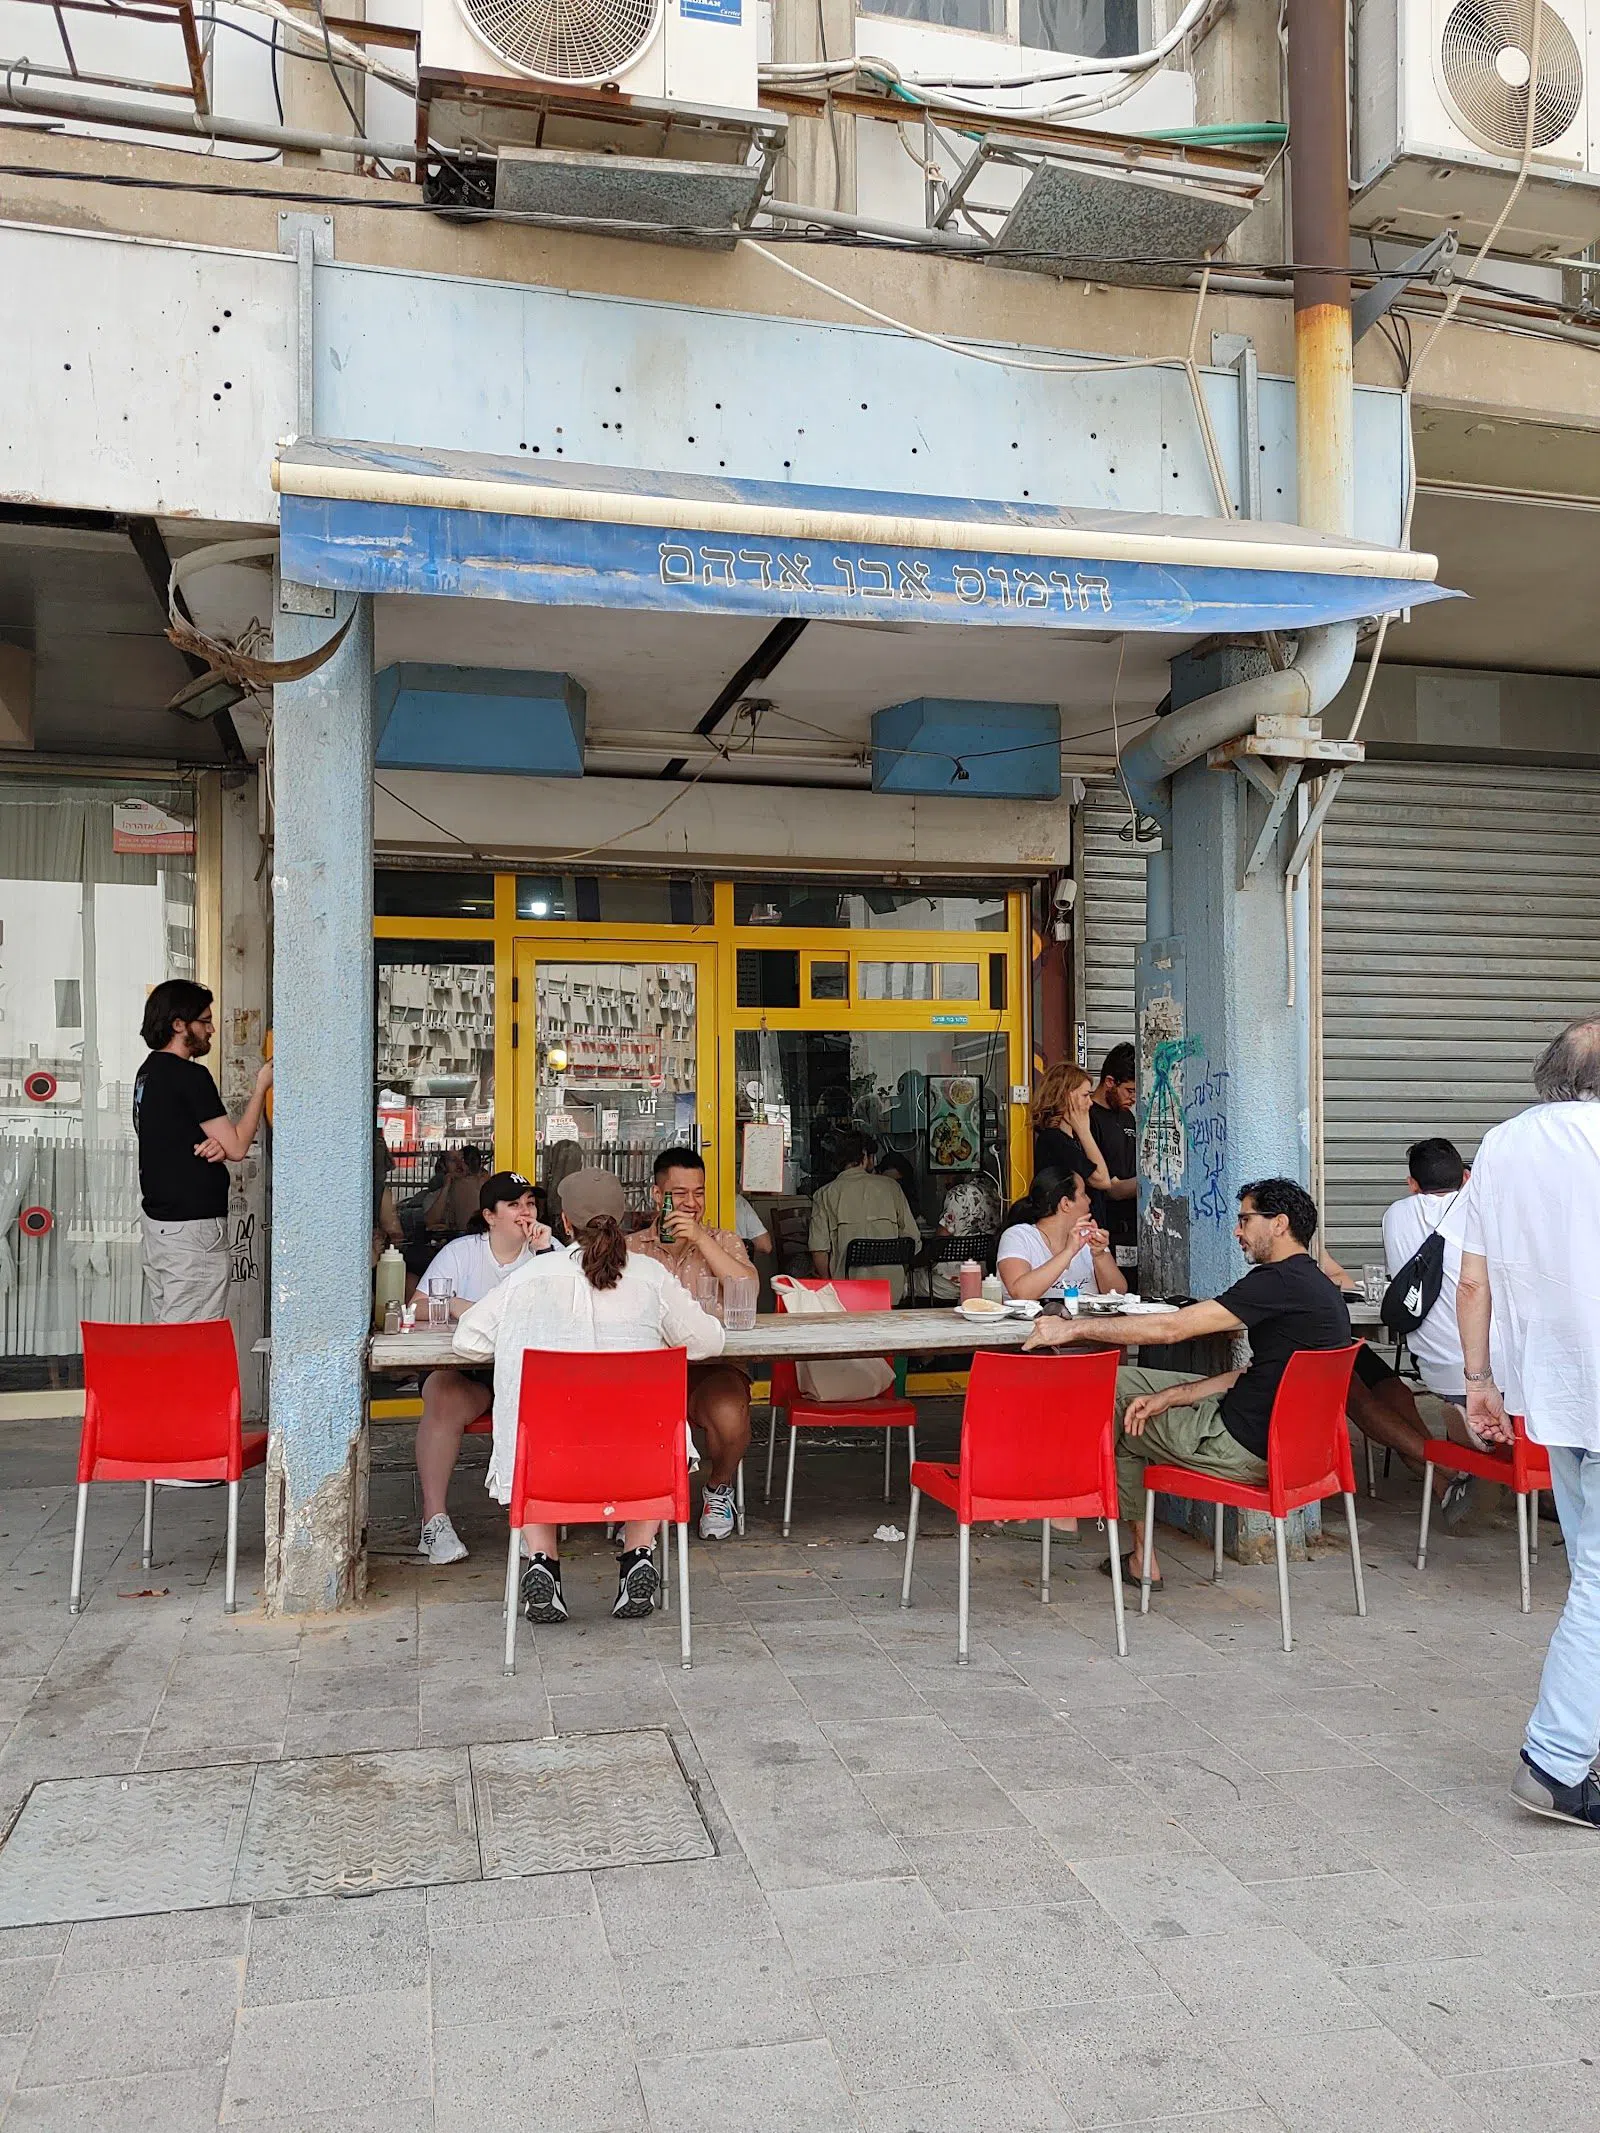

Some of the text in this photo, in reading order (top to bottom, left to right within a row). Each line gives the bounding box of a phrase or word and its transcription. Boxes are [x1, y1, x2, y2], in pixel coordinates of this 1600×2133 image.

[658, 542, 1114, 613] חומוס אבו אדהם
[1403, 1285, 1419, 1310] NIKE
